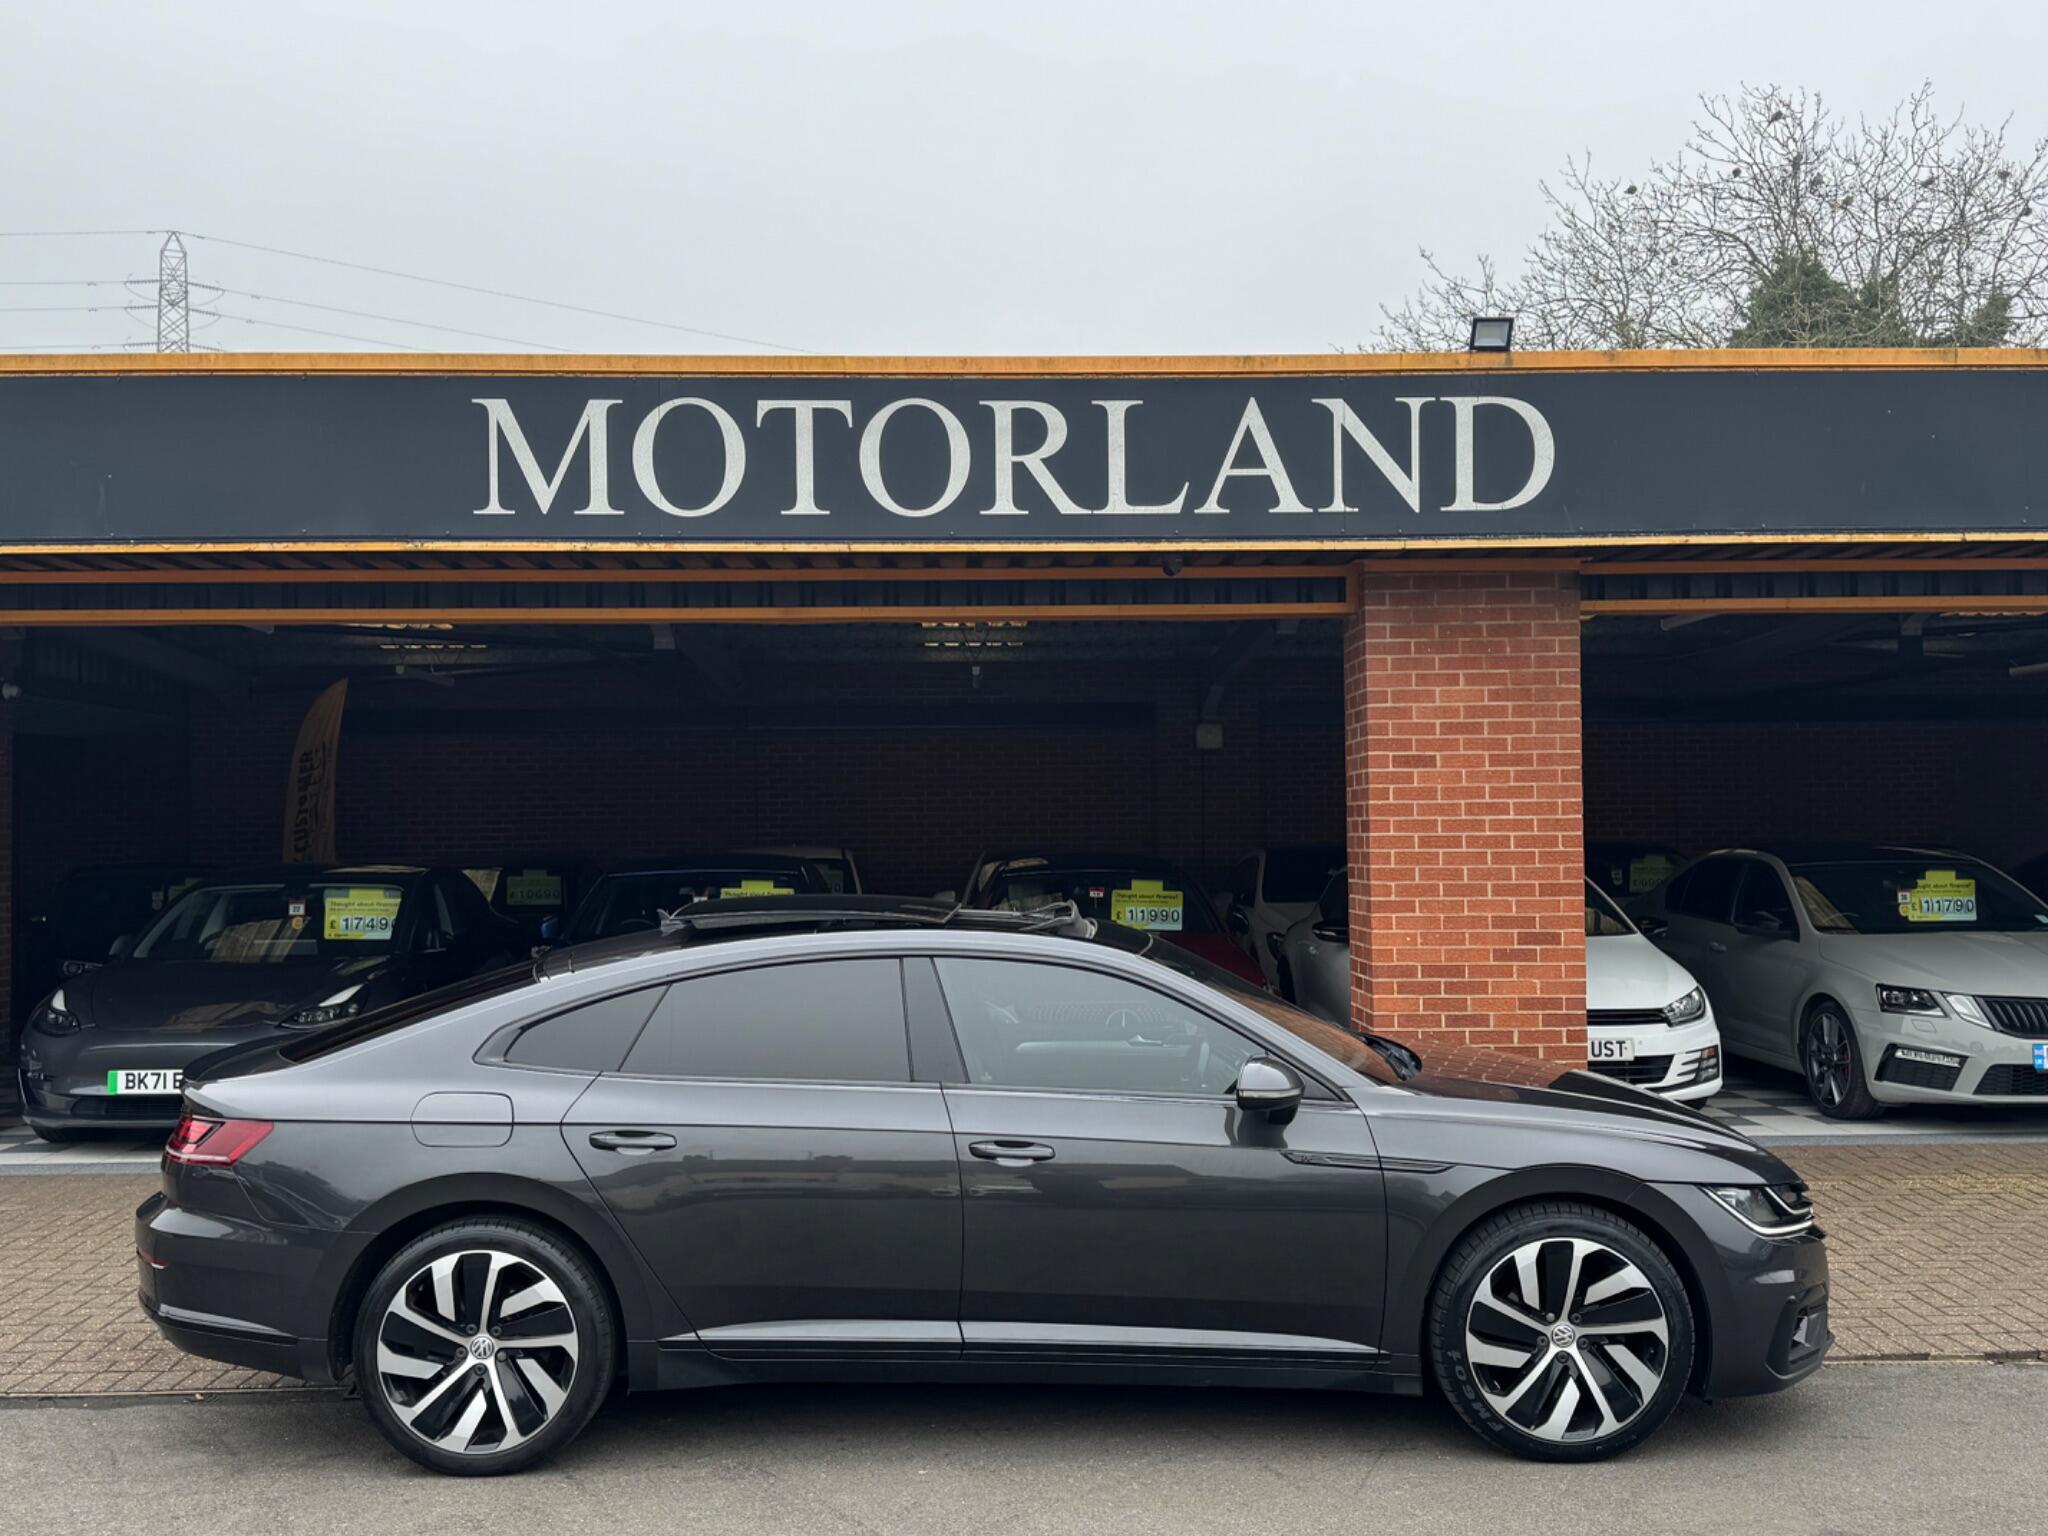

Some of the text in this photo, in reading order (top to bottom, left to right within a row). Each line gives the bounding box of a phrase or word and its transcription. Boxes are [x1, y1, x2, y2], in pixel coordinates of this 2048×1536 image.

[471, 397, 1555, 518] MOTORLAND
[1924, 899, 1974, 913] 11790
[1127, 909, 1180, 922] 11990
[1591, 1040, 1626, 1058] UST
[125, 1072, 167, 1090] BK71
